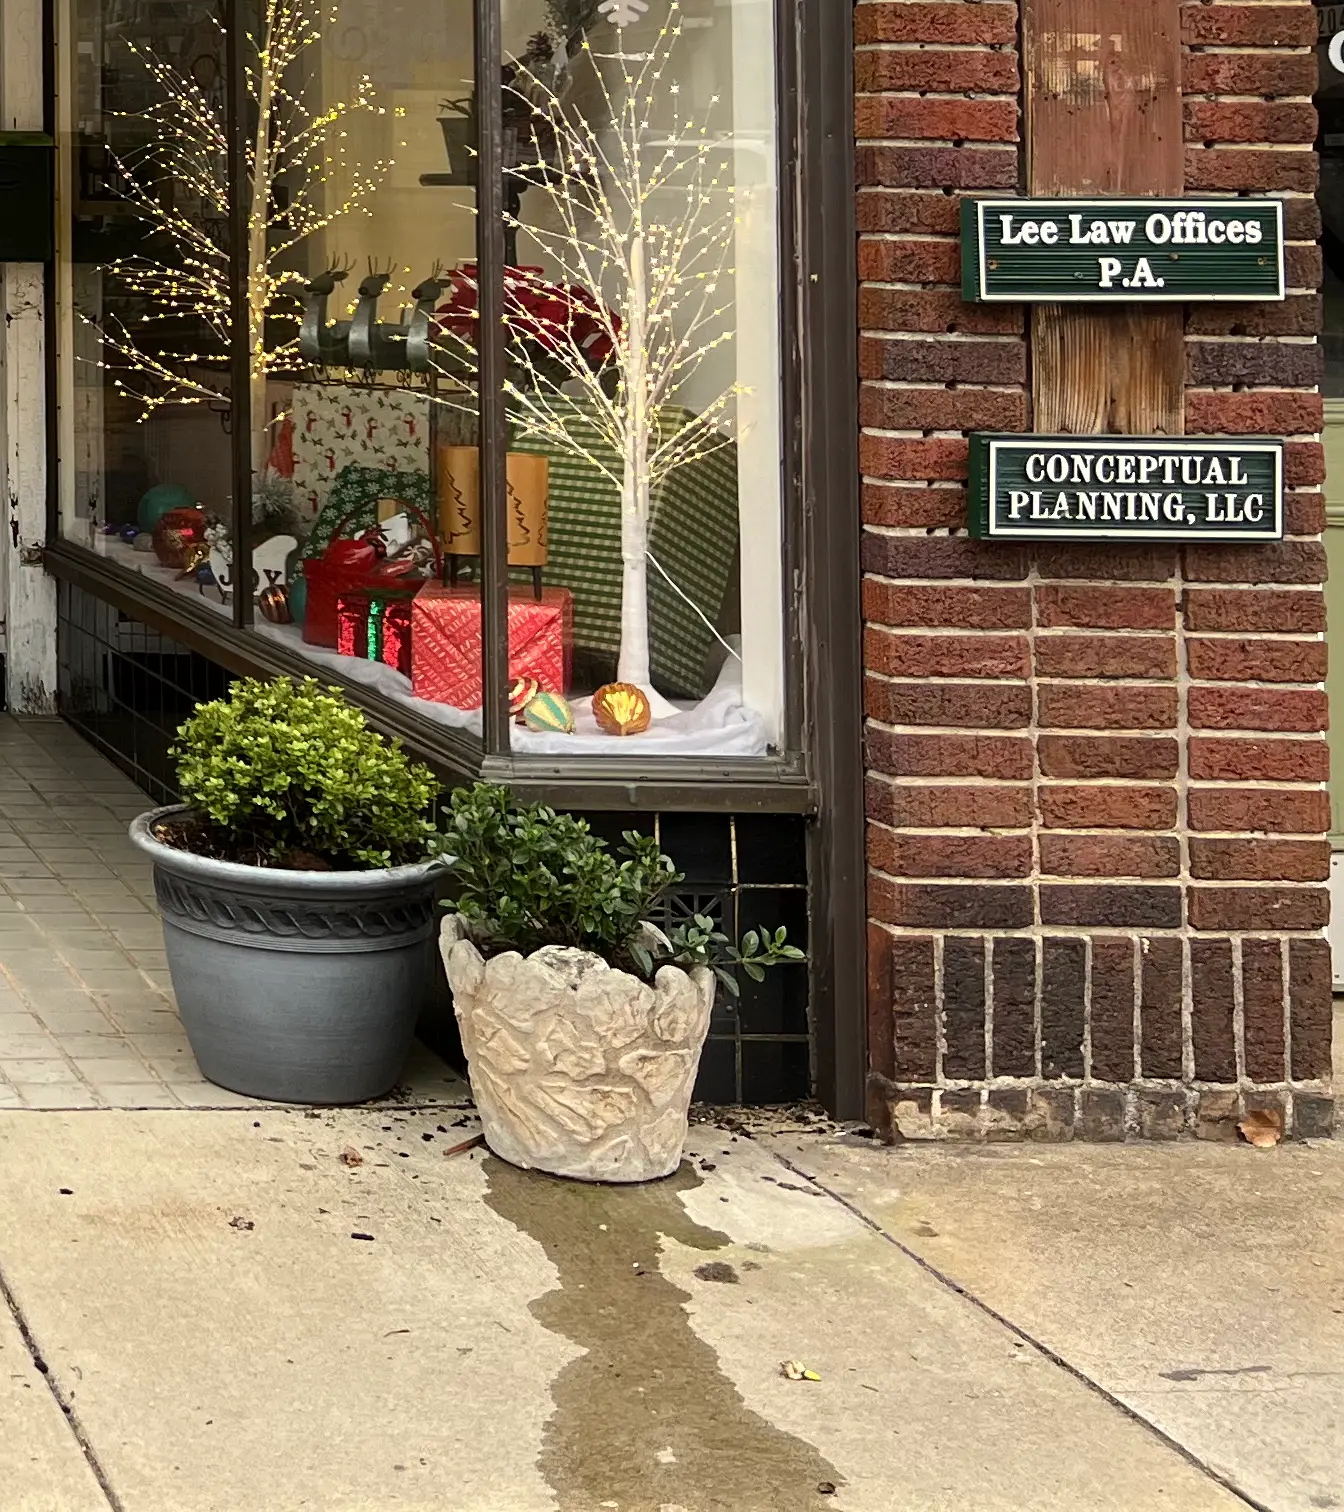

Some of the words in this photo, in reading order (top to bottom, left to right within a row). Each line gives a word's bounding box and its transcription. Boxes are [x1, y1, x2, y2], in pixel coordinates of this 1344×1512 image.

[999, 214, 1059, 245] Lee
[1068, 214, 1137, 245] Law
[1145, 211, 1263, 245] Offices
[1097, 256, 1165, 289] P.A.
[1025, 452, 1248, 485] CONCEPTUAL
[1007, 490, 1196, 525] PLANNING,
[1204, 491, 1265, 523] LLC
